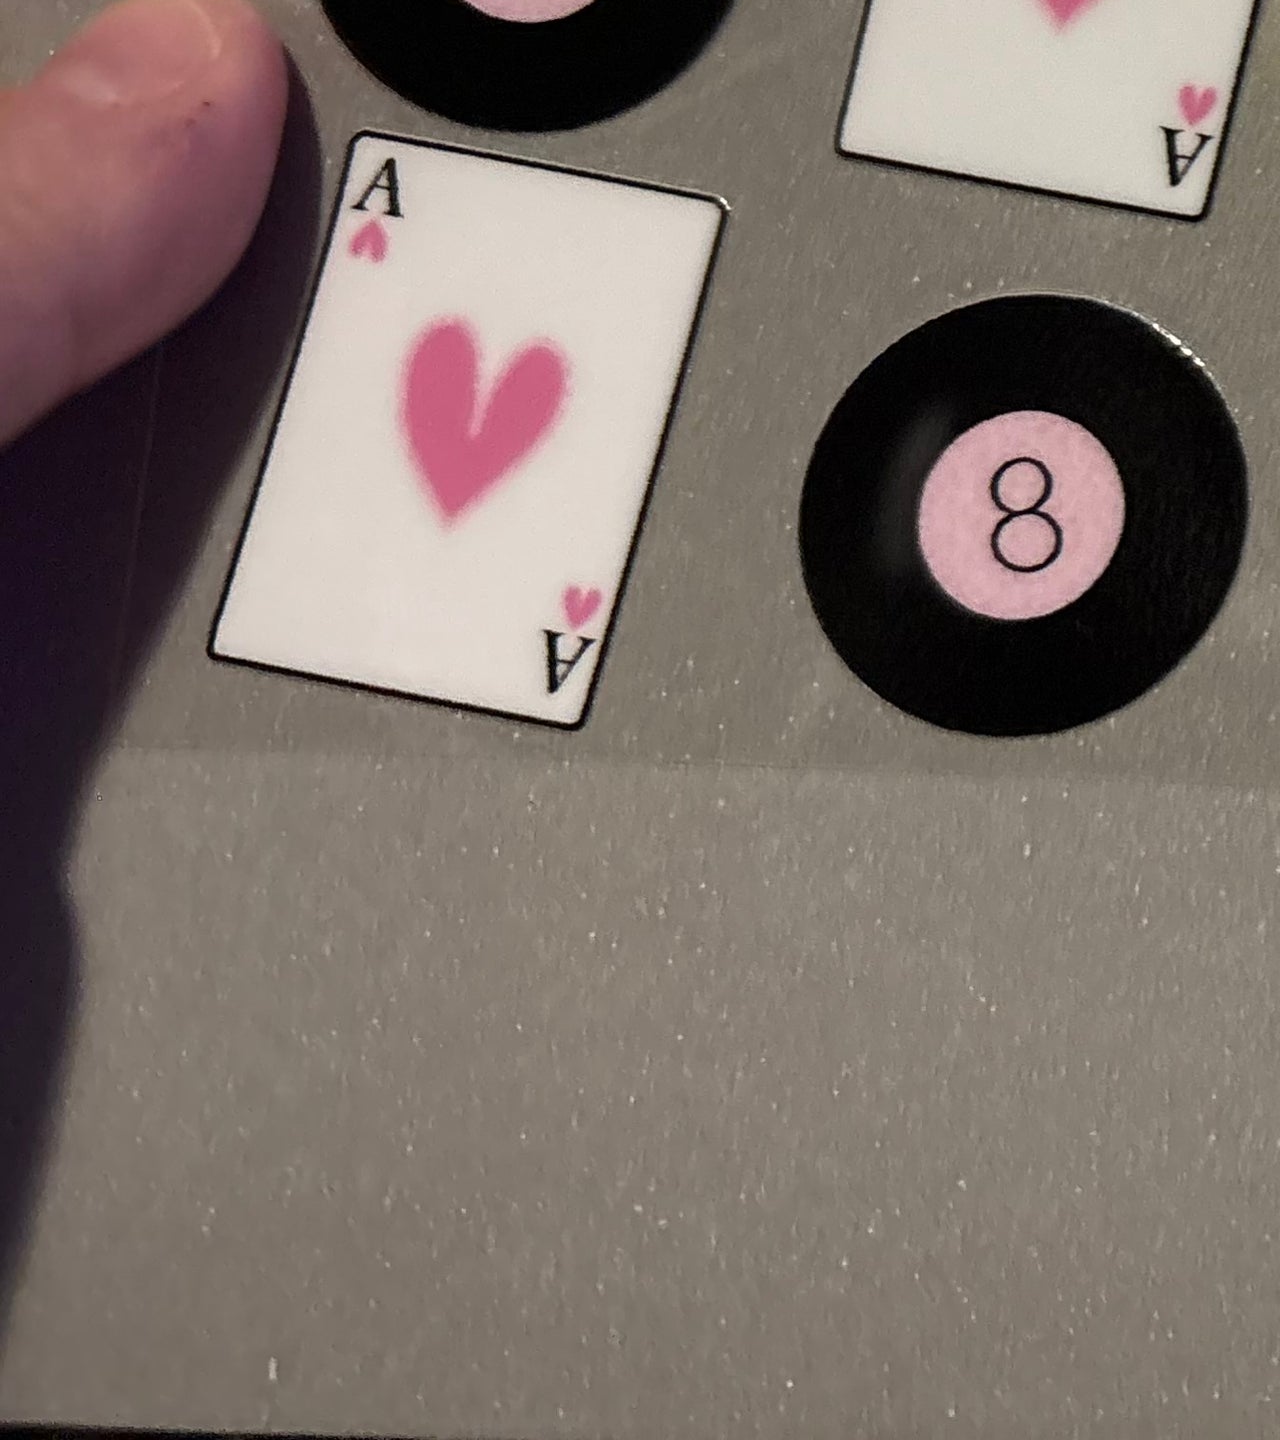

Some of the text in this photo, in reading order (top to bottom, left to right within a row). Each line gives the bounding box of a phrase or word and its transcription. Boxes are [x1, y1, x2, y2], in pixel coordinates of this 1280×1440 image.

[1161, 126, 1213, 186] A
[352, 158, 403, 217] A
[988, 457, 1063, 573] 8
[544, 630, 595, 693] A
